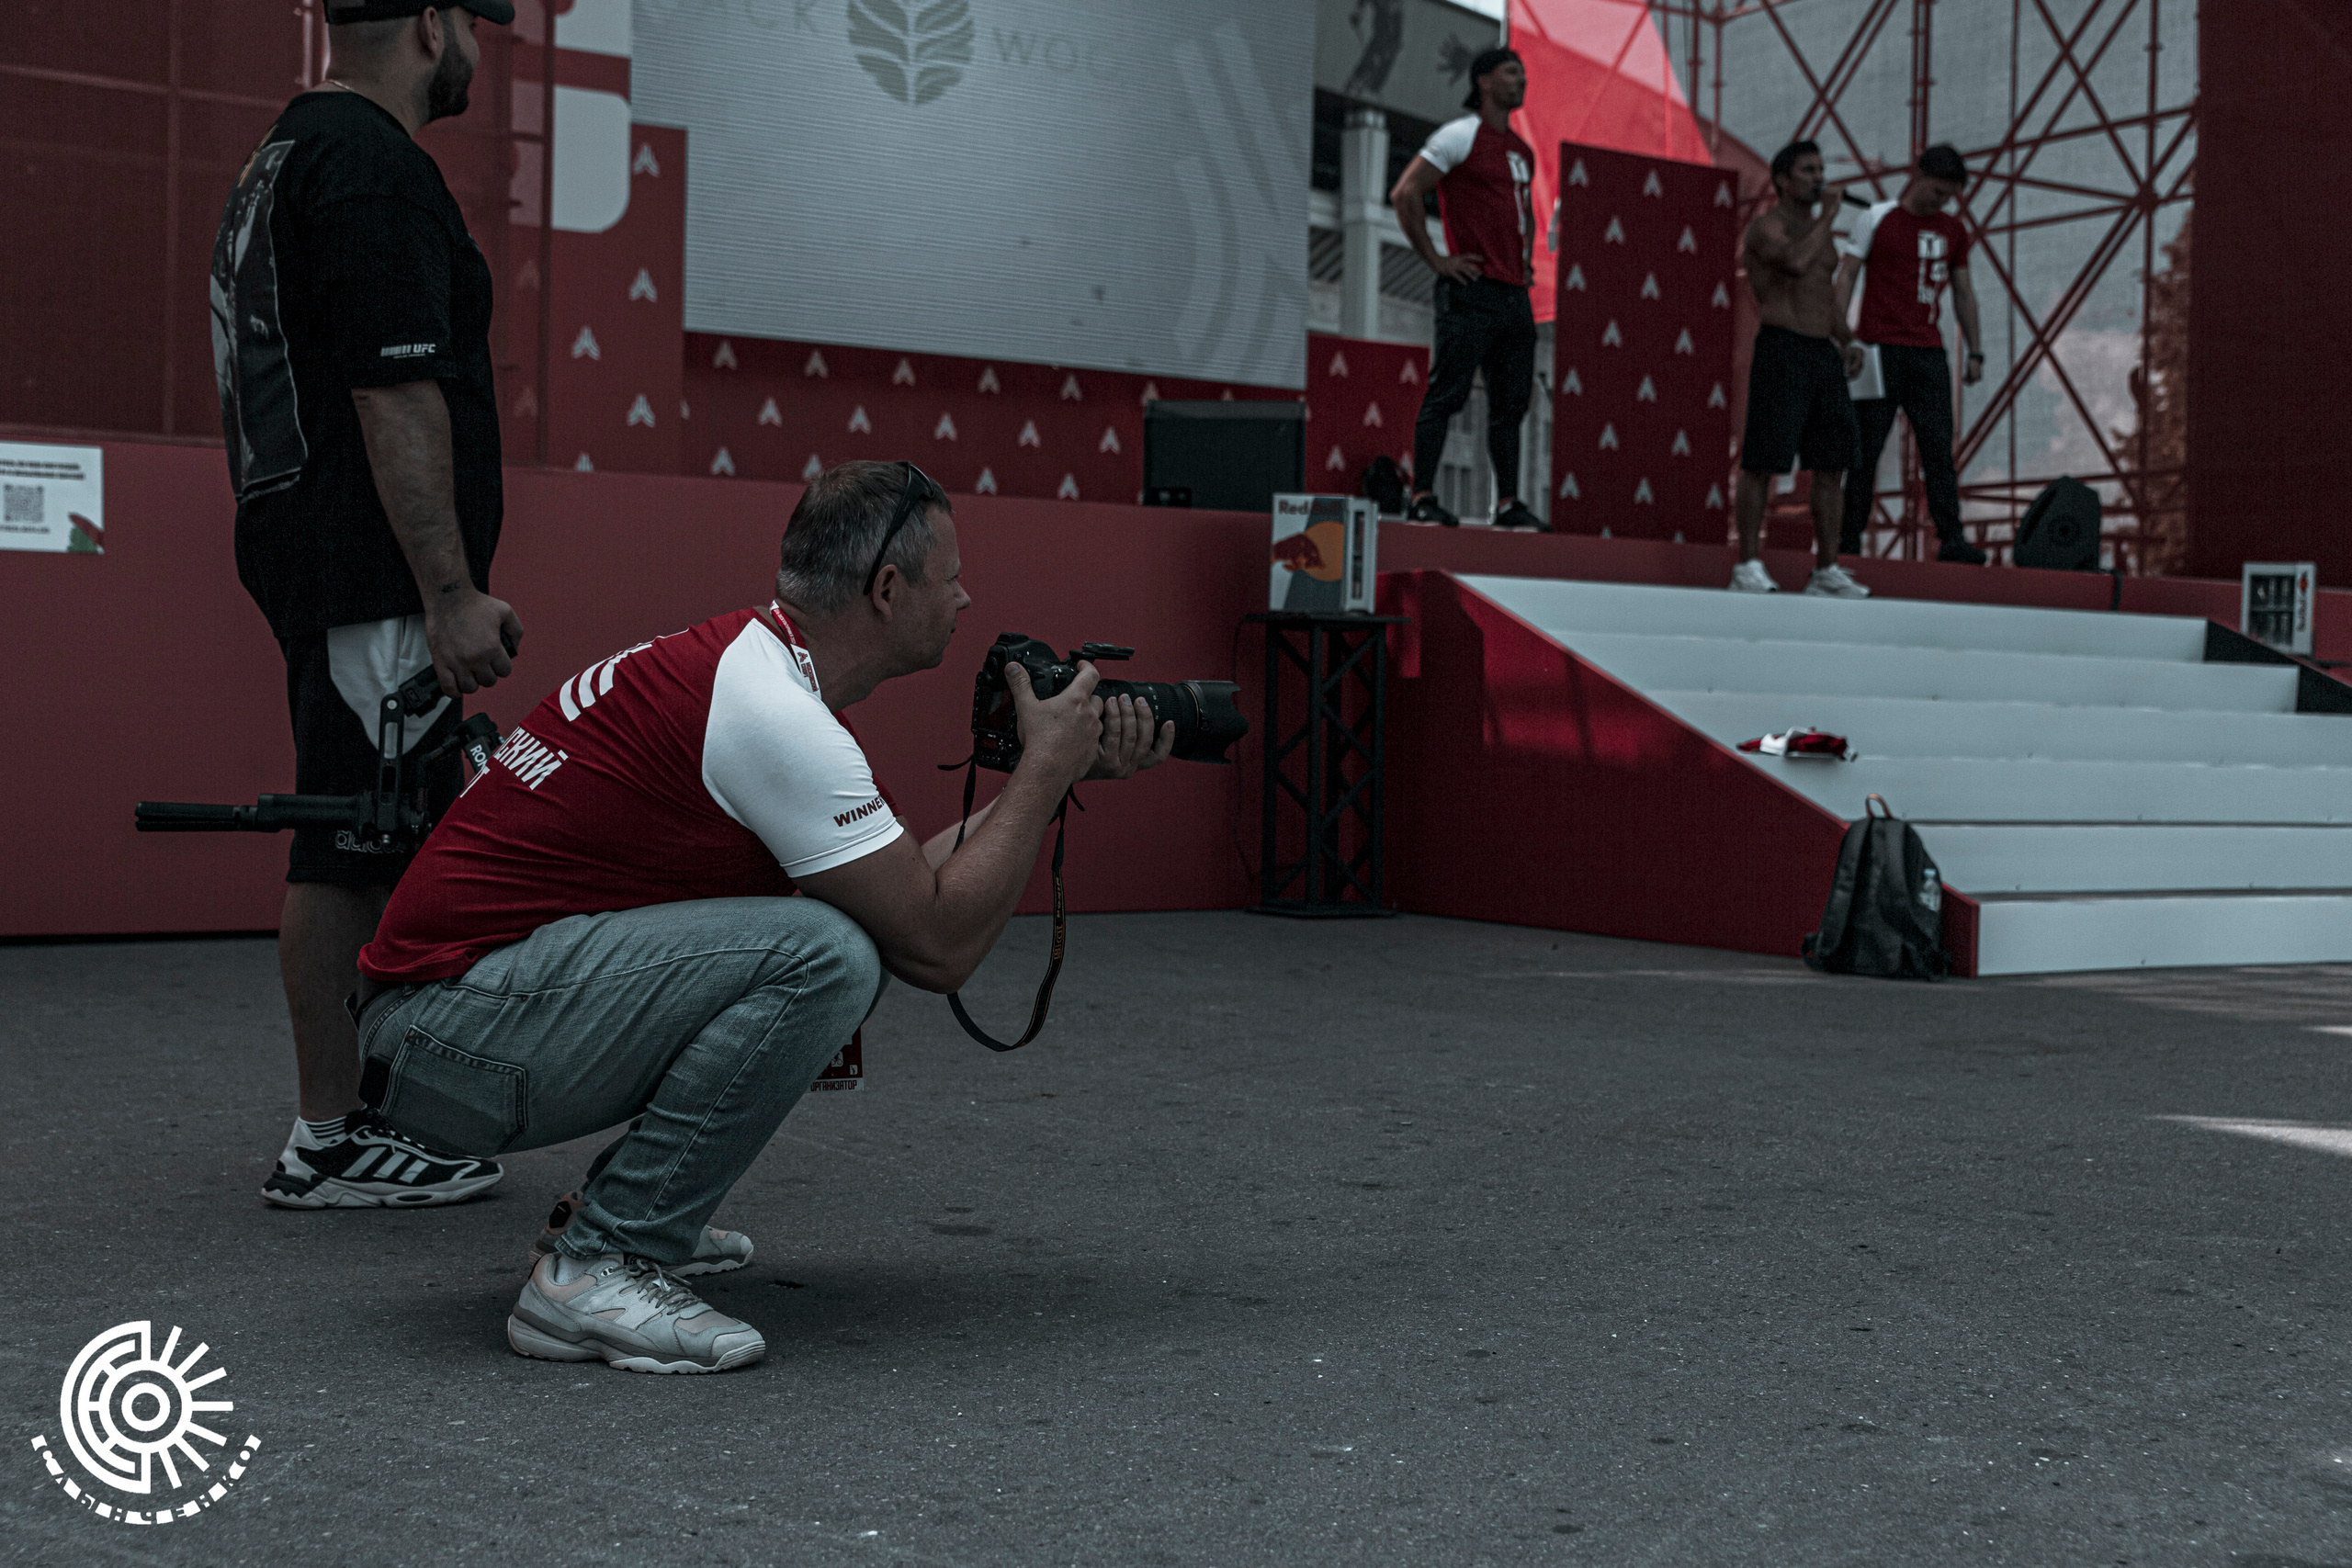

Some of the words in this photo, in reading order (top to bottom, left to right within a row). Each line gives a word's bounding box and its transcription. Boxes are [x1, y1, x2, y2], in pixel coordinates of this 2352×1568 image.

[413, 344, 436, 354] UFC
[1278, 499, 1308, 514] Red
[492, 727, 569, 791] СКИЙ
